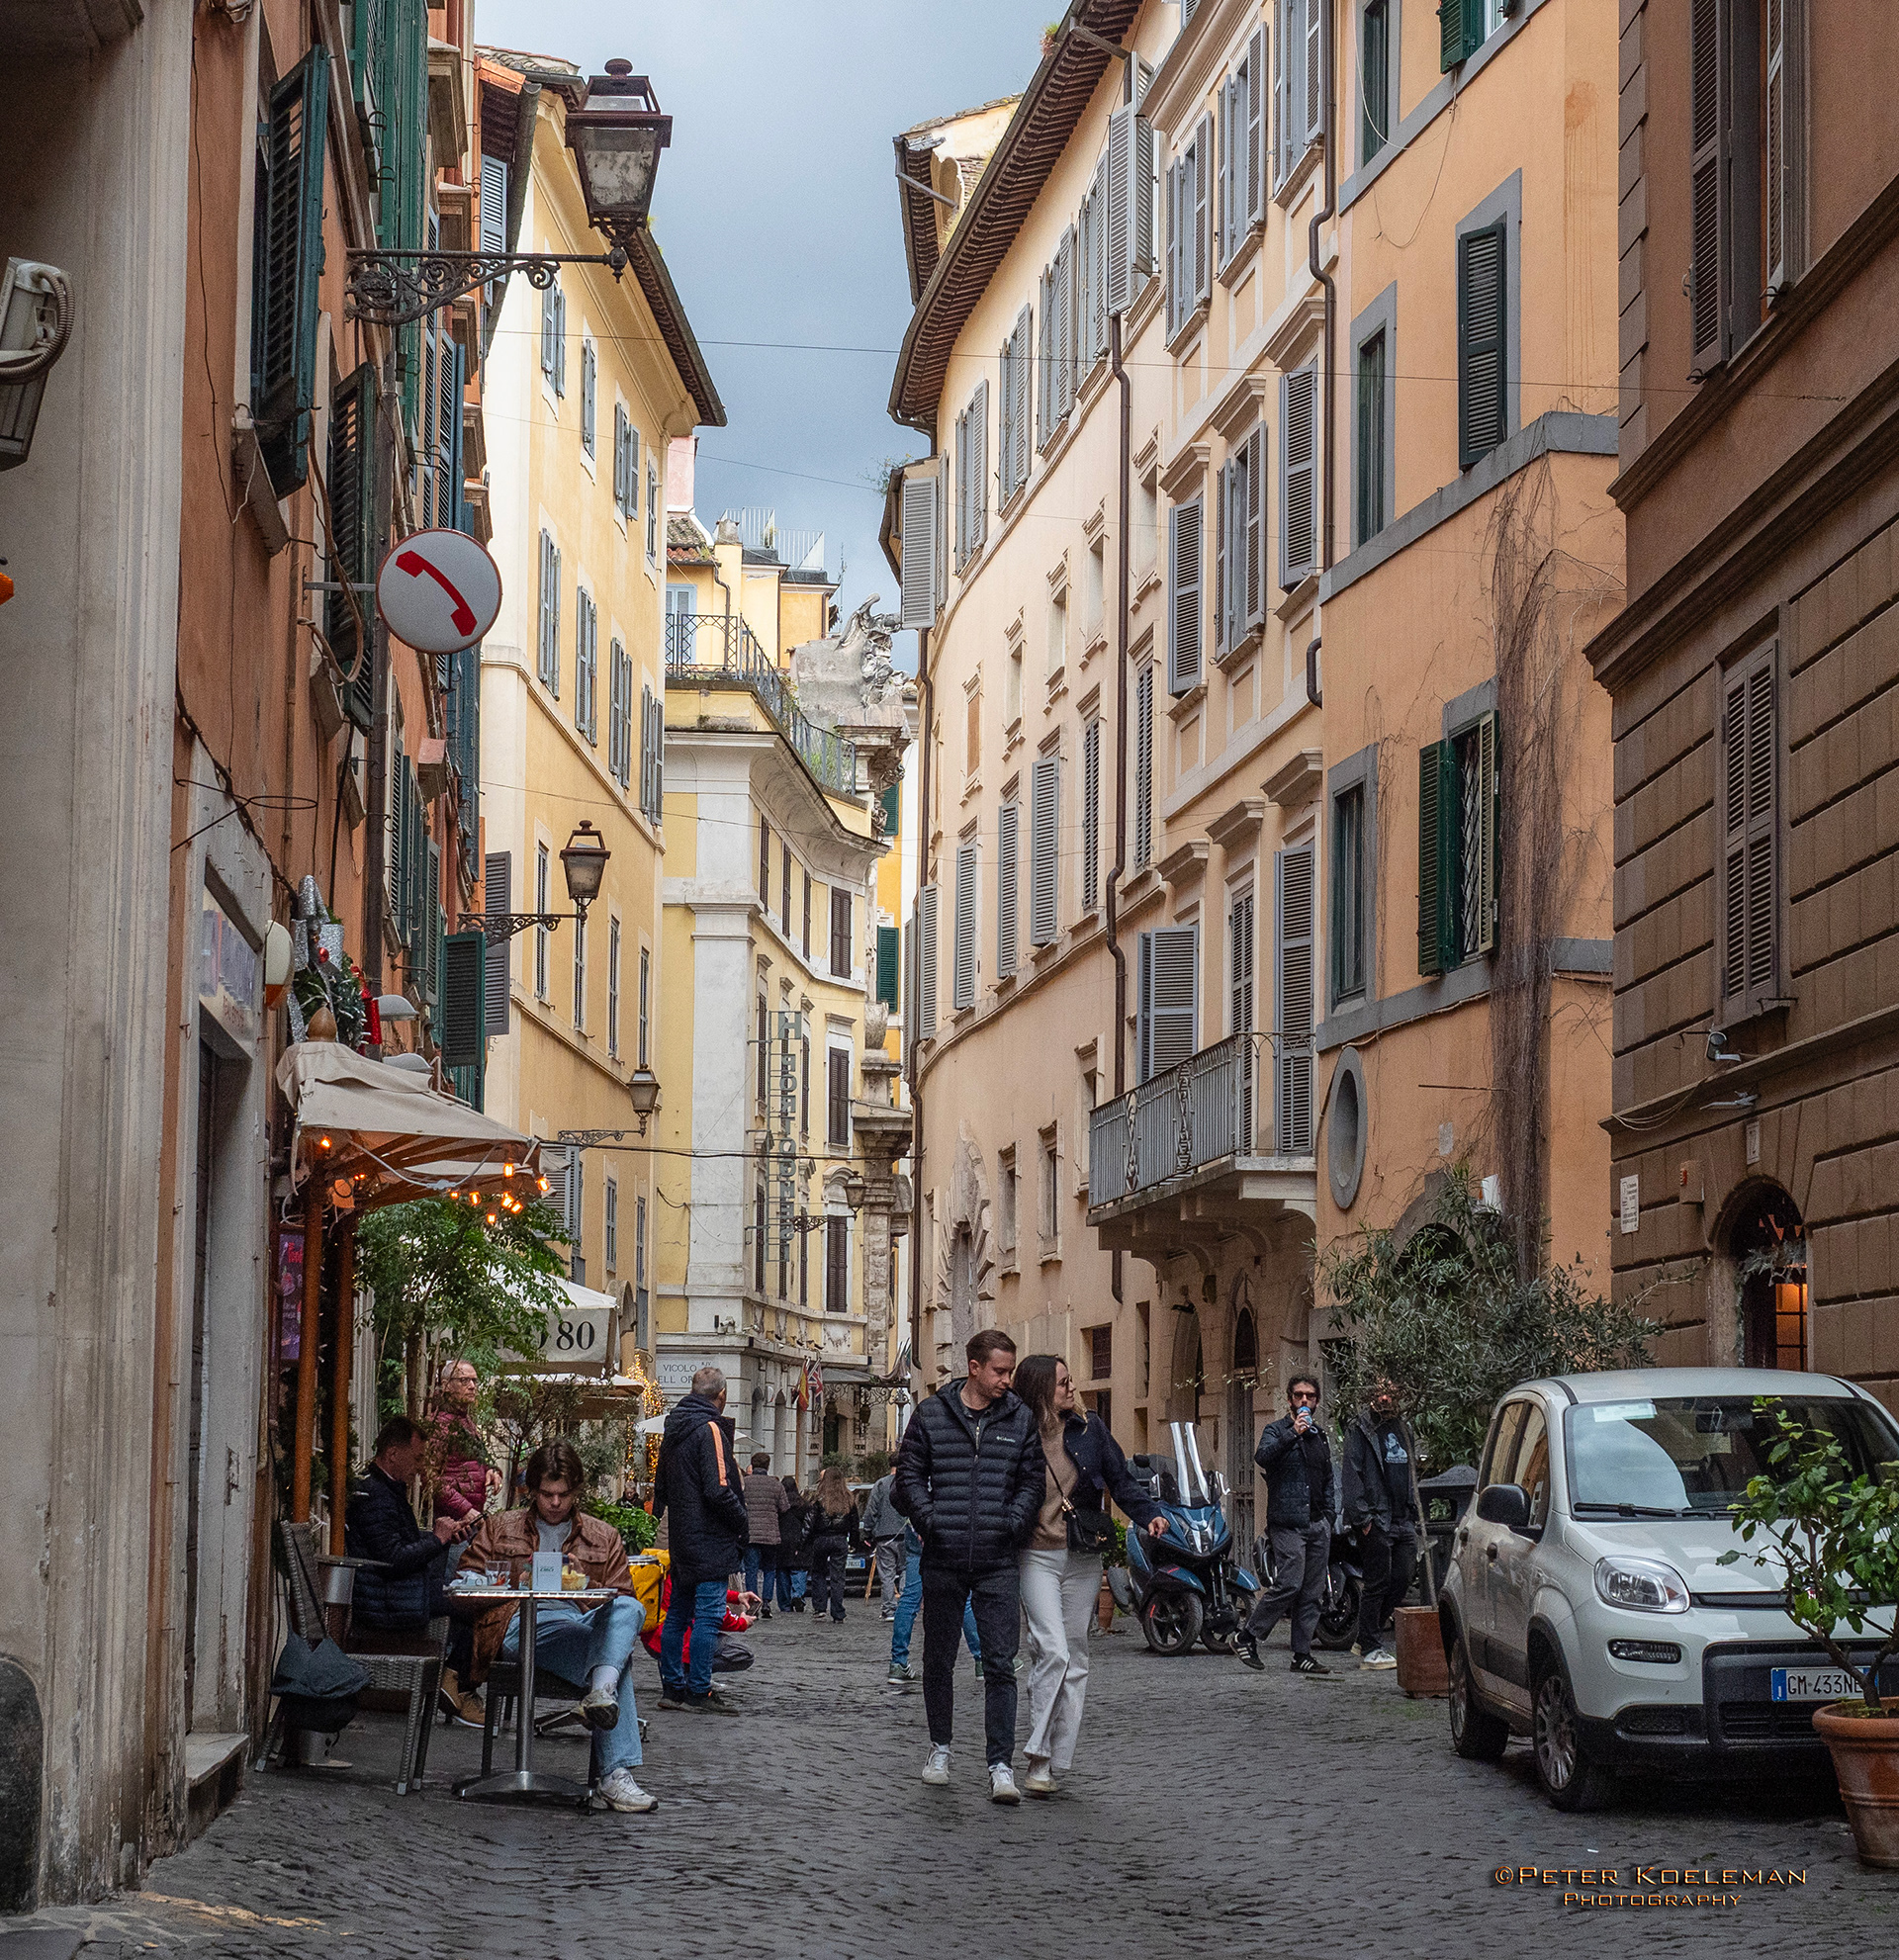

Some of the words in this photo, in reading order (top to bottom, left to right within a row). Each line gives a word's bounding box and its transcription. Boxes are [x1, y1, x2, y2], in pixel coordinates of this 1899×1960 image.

[556, 1321, 594, 1351] 80
[663, 1364, 697, 1373] VICOLO
[657, 1375, 676, 1383] ELL'
